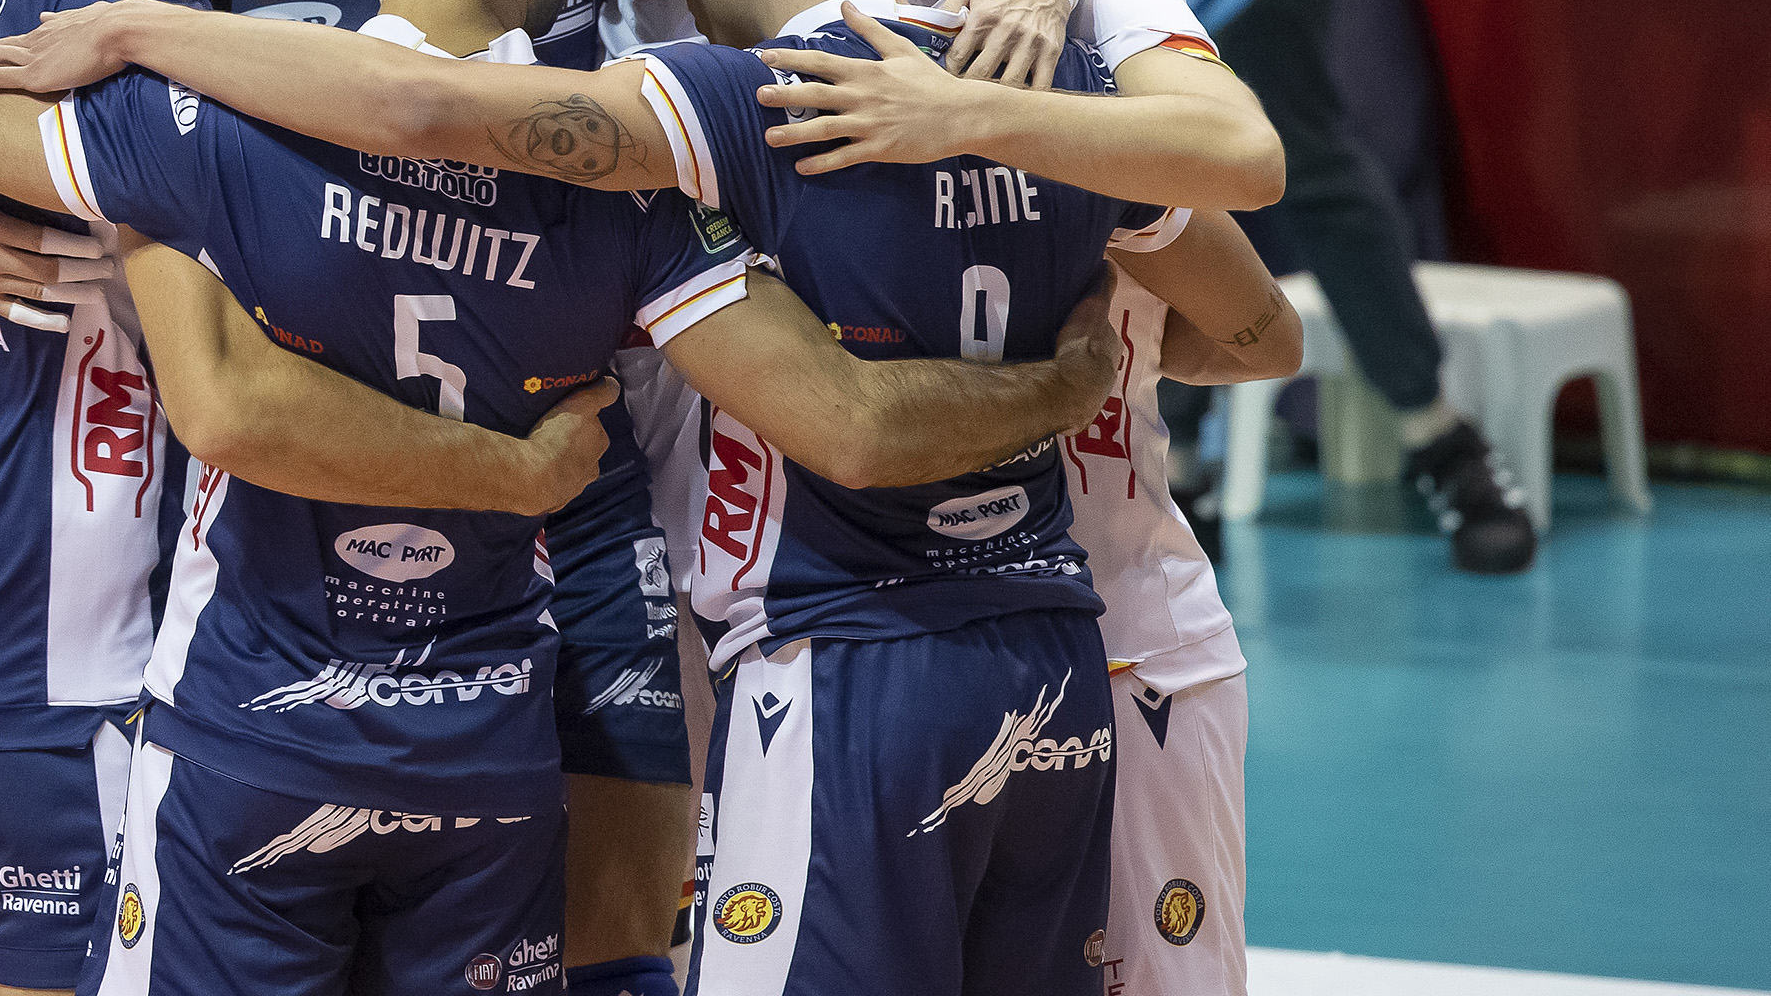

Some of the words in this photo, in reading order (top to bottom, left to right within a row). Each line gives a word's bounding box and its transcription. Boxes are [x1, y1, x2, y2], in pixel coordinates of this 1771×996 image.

[359, 151, 497, 207] BORTOLO
[321, 182, 541, 290] REDWITZ
[706, 216, 729, 234] CREDEM
[842, 325, 906, 344] CONAD
[394, 294, 467, 423] 5
[543, 370, 598, 390] CONAD
[84, 366, 144, 478] RM
[702, 428, 763, 562] RM
[938, 509, 977, 527] MAC
[978, 494, 1021, 519] PORT
[346, 539, 392, 559] MAC
[0, 865, 81, 890] Ghetti
[2, 893, 80, 915] Ravenna
[715, 889, 736, 915] PORTO
[736, 883, 768, 894] ROBUR
[767, 891, 781, 918] COSTA
[1156, 892, 1167, 922] PORTO
[1187, 885, 1204, 910] COSTA
[722, 928, 768, 943] RAVENNA
[474, 963, 495, 981] FIAT
